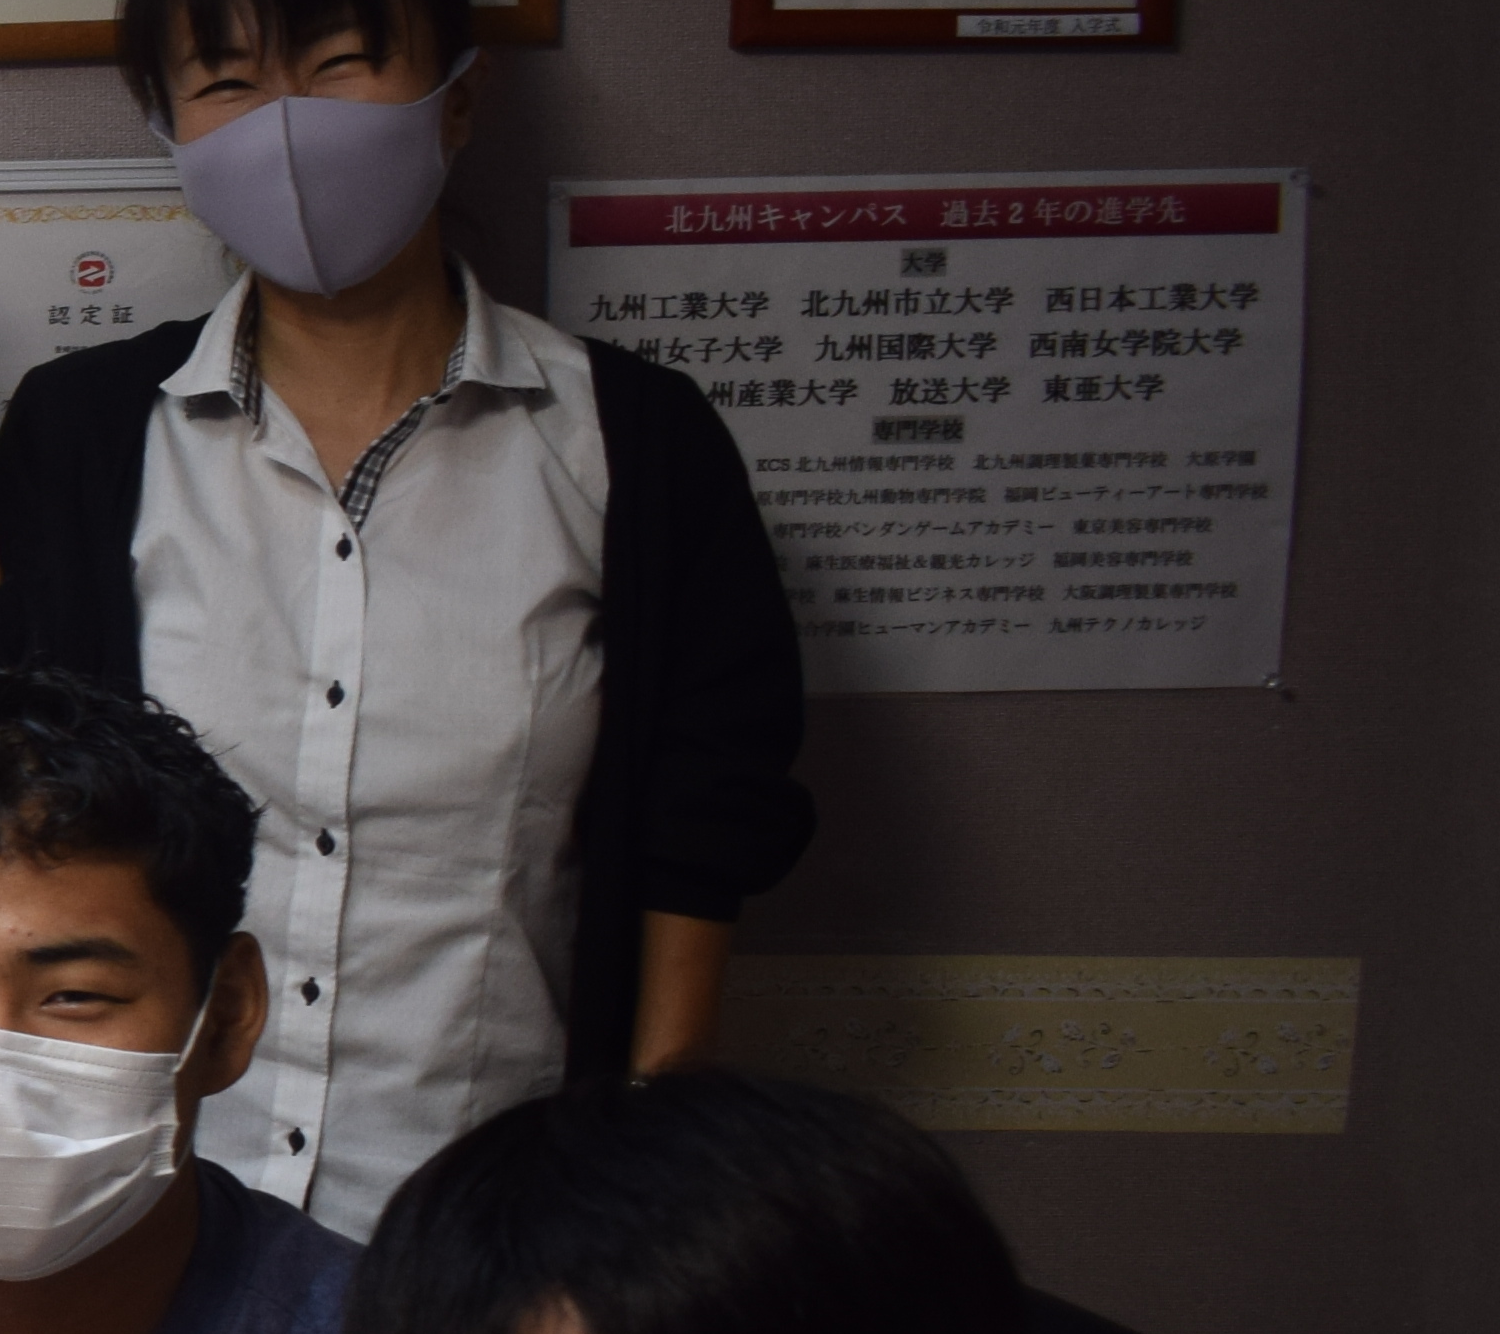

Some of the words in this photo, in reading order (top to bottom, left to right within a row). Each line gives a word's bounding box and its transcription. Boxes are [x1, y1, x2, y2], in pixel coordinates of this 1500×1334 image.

[1071, 17, 1121, 33] 入学式
[664, 202, 908, 234] 北九州キャンパス
[903, 252, 946, 274] 大学
[589, 291, 770, 322] 九州工業大学
[801, 285, 1014, 317] 北九州市立大学
[1046, 282, 1260, 313] 西日本工業大学
[48, 305, 135, 326] 認定証
[612, 335, 782, 366] 州女子大学
[815, 331, 997, 363] 九州国際大学
[1029, 327, 1243, 358] 西南女学院大学
[889, 374, 1011, 405] 放送大学
[1042, 373, 1165, 403] 東亜大学
[873, 419, 962, 441] 専門学校
[756, 458, 790, 472] KCS
